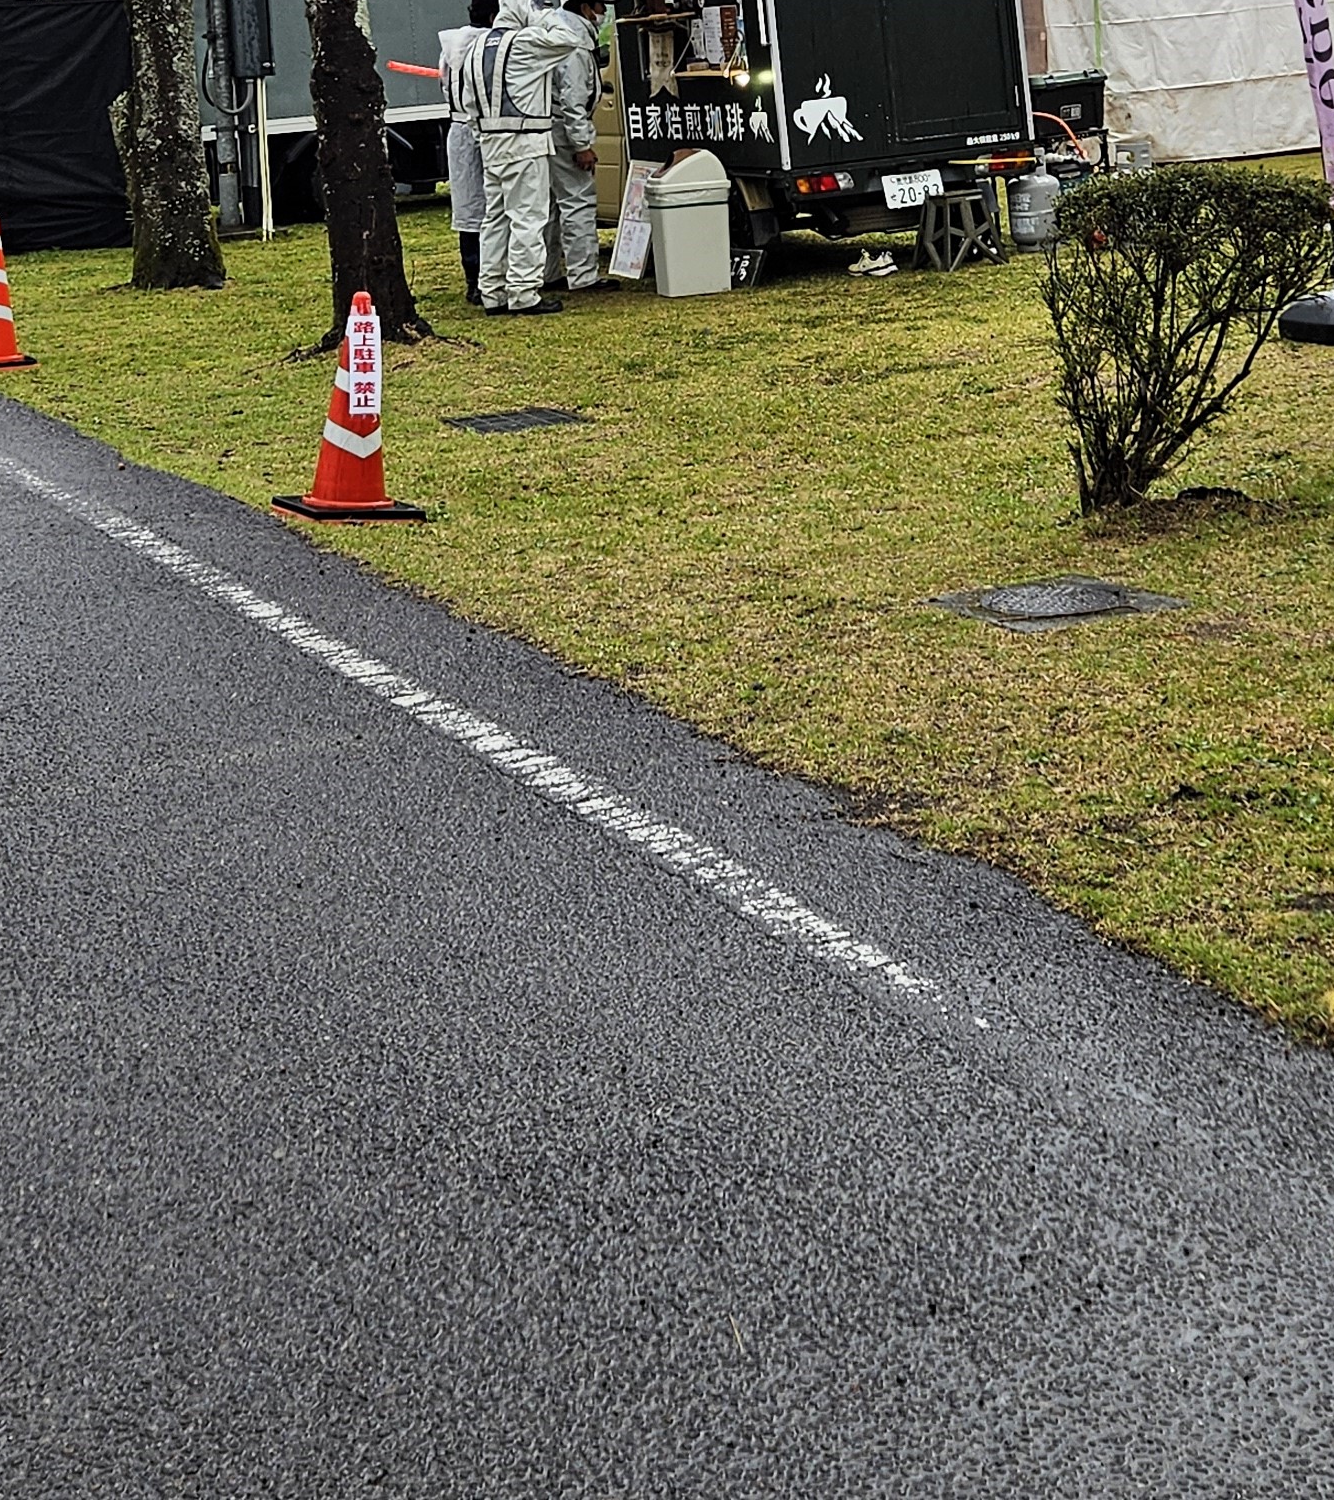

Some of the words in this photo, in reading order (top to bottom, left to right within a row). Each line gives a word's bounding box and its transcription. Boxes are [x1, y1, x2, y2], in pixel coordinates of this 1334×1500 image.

[628, 102, 745, 142] 自家焙煎珈琲
[353, 321, 375, 375] 路上駐車
[353, 381, 376, 408] 禁止
